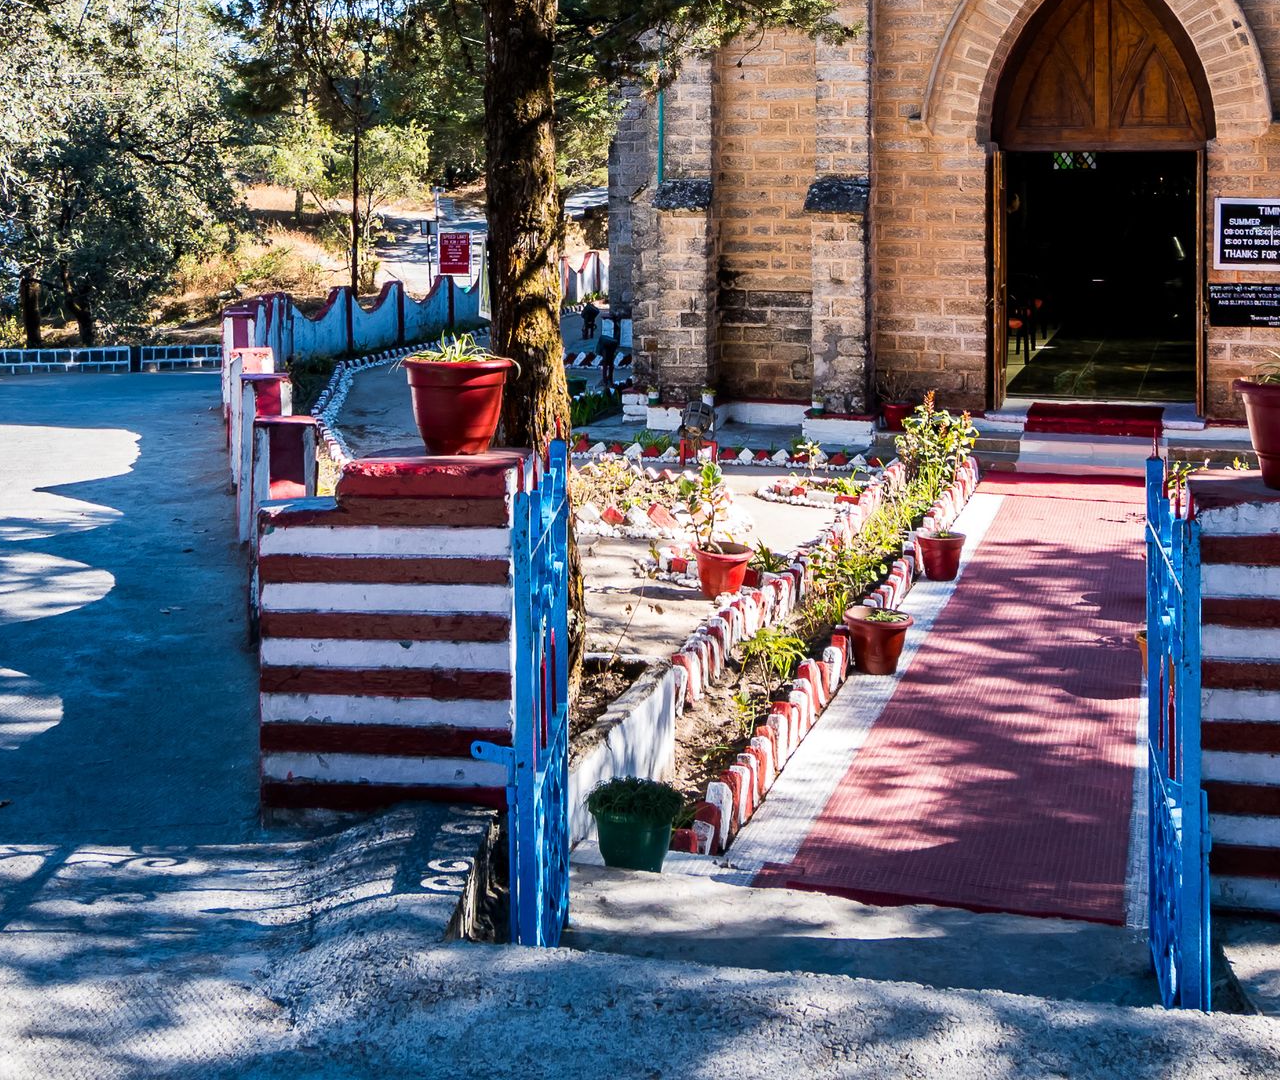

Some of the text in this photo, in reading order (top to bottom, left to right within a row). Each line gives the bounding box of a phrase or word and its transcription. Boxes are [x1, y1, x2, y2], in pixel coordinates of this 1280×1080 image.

[1245, 228, 1254, 236] TO
[1224, 249, 1259, 258] THANKS
[1261, 250, 1277, 259] FOR
